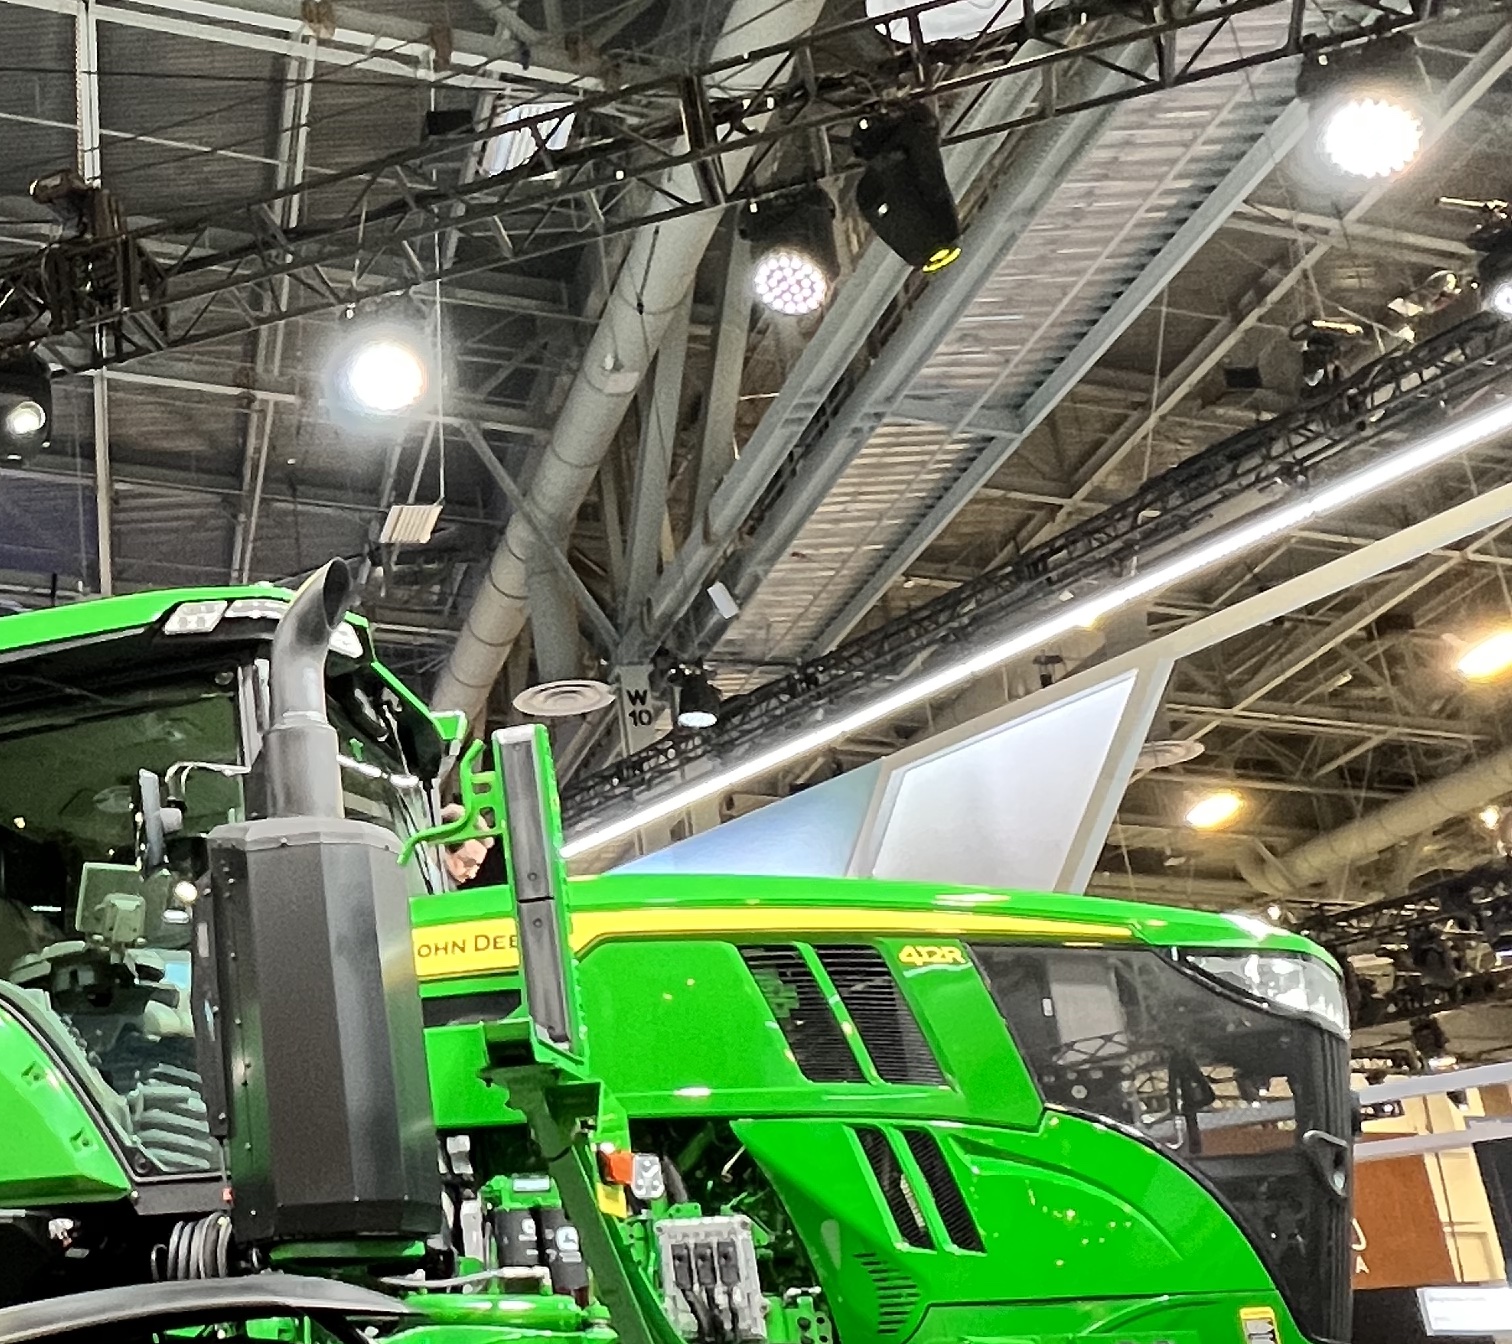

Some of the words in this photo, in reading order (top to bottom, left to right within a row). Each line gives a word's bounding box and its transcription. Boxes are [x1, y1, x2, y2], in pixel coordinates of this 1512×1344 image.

[626, 689, 648, 706] W
[628, 709, 652, 727] 10
[417, 939, 466, 958] OHN
[474, 934, 517, 952] DEE
